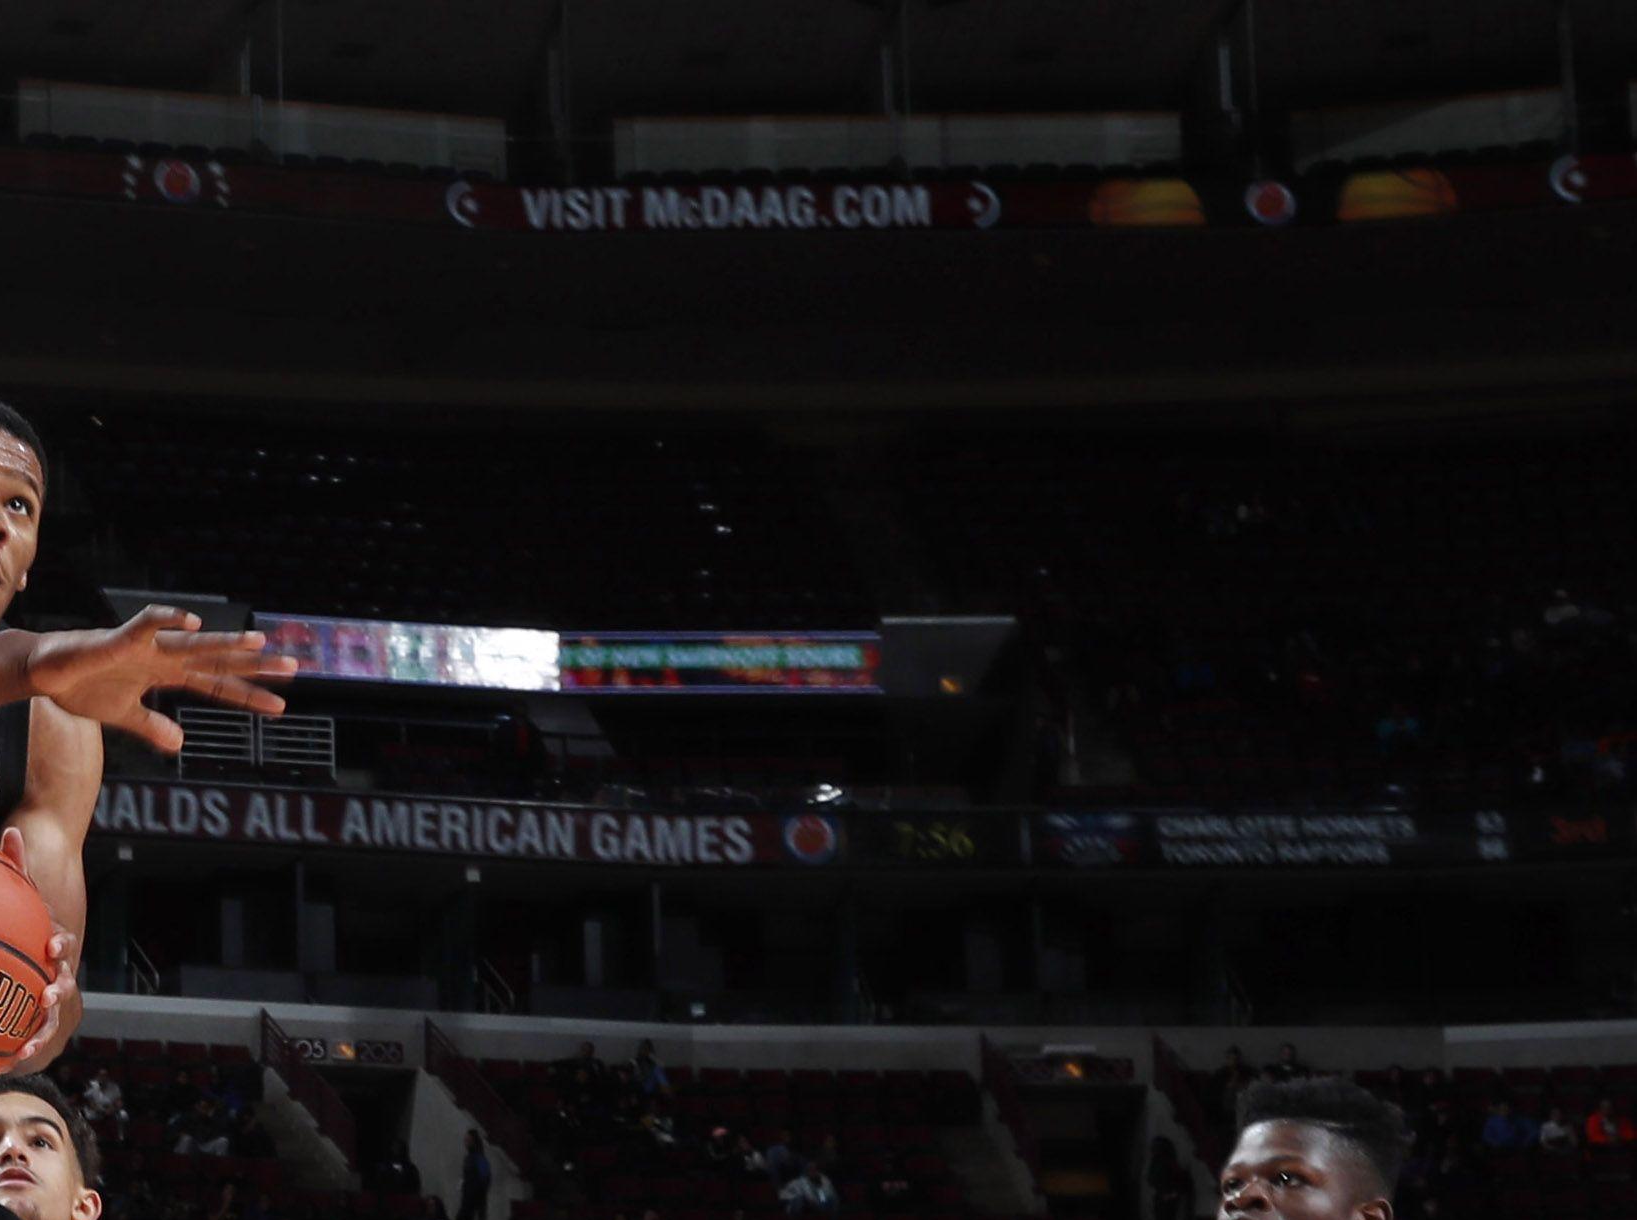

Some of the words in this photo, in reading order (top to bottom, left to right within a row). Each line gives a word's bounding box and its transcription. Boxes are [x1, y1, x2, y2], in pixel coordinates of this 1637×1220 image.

[520, 186, 631, 231] VISIT
[642, 184, 933, 230] McDAAG.COM
[243, 791, 329, 844] ALL
[339, 798, 577, 862] AMERICAN
[590, 811, 754, 865] GAMES
